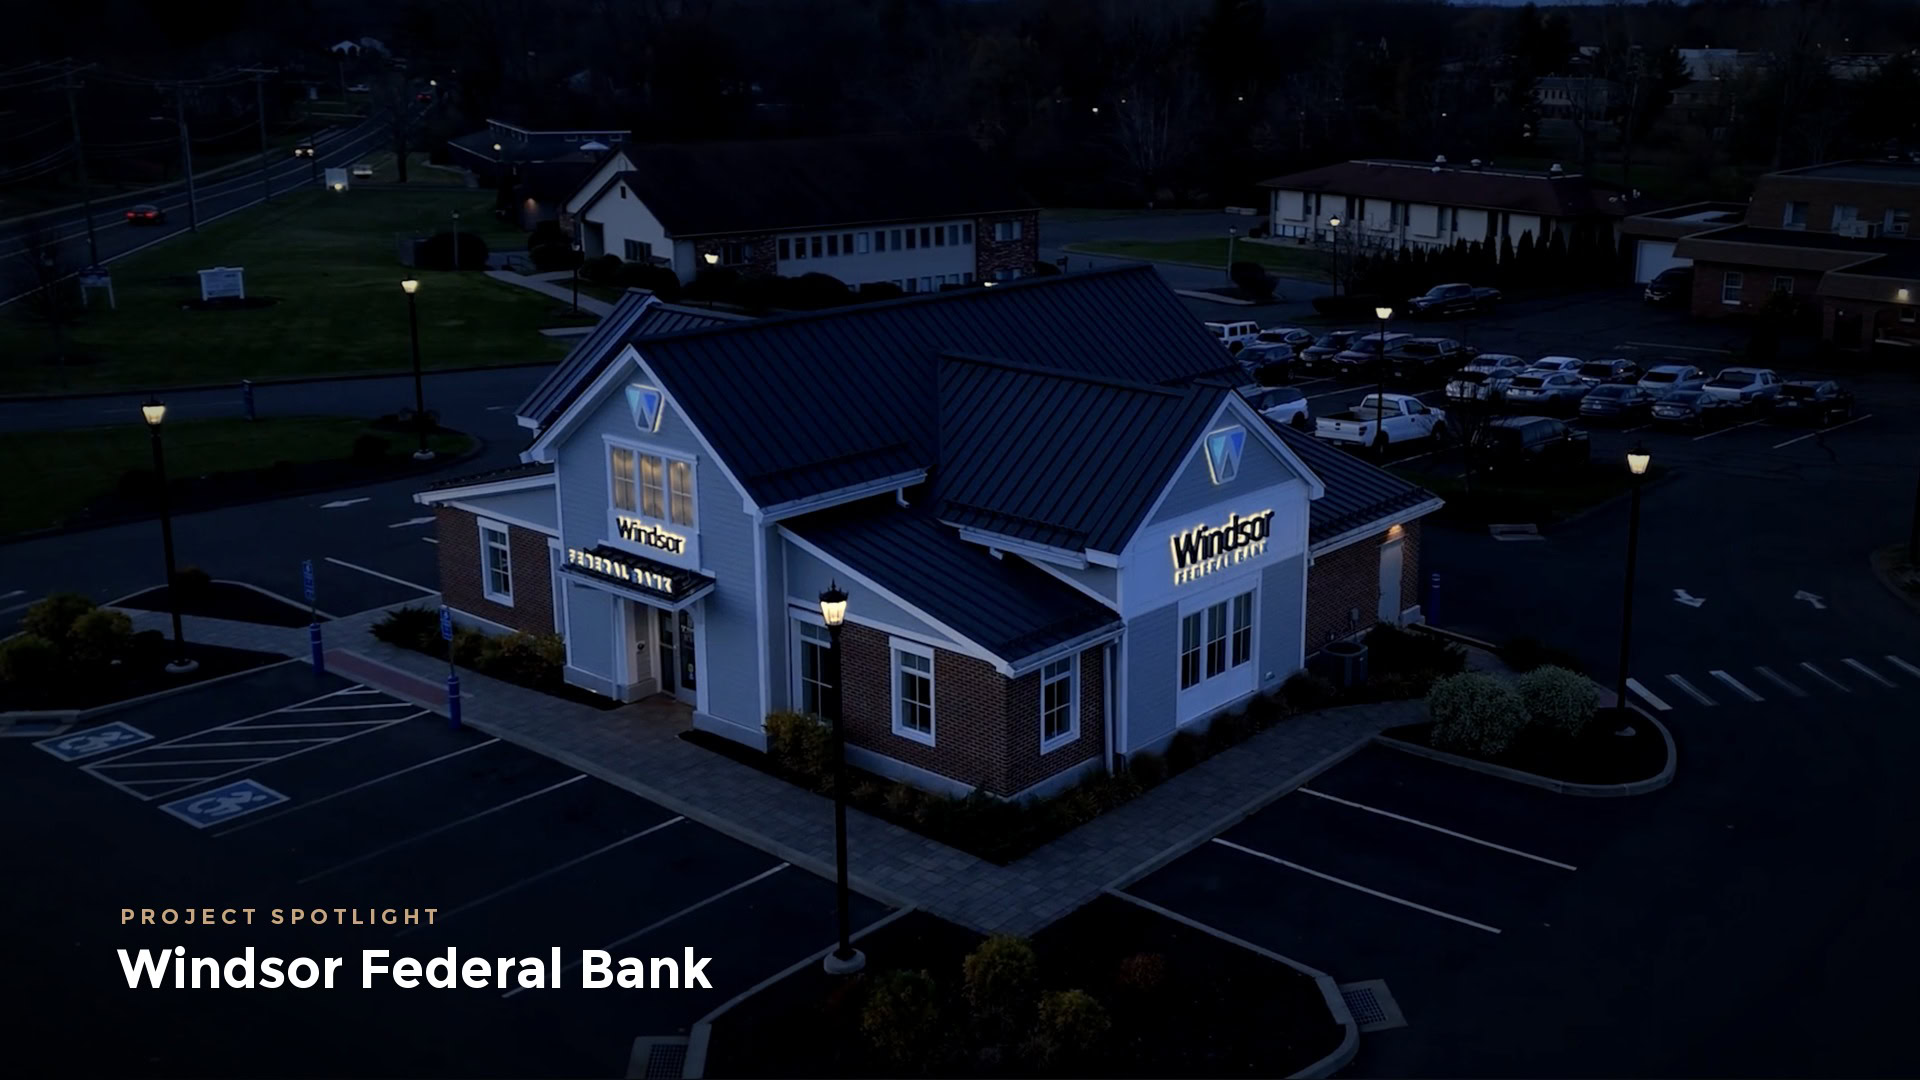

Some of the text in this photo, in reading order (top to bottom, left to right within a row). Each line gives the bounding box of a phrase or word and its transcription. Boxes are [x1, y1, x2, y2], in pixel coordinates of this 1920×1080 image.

[616, 516, 685, 554] Windsor
[1172, 510, 1275, 569] Windsor
[1174, 540, 1268, 586] FEDERAL BANK
